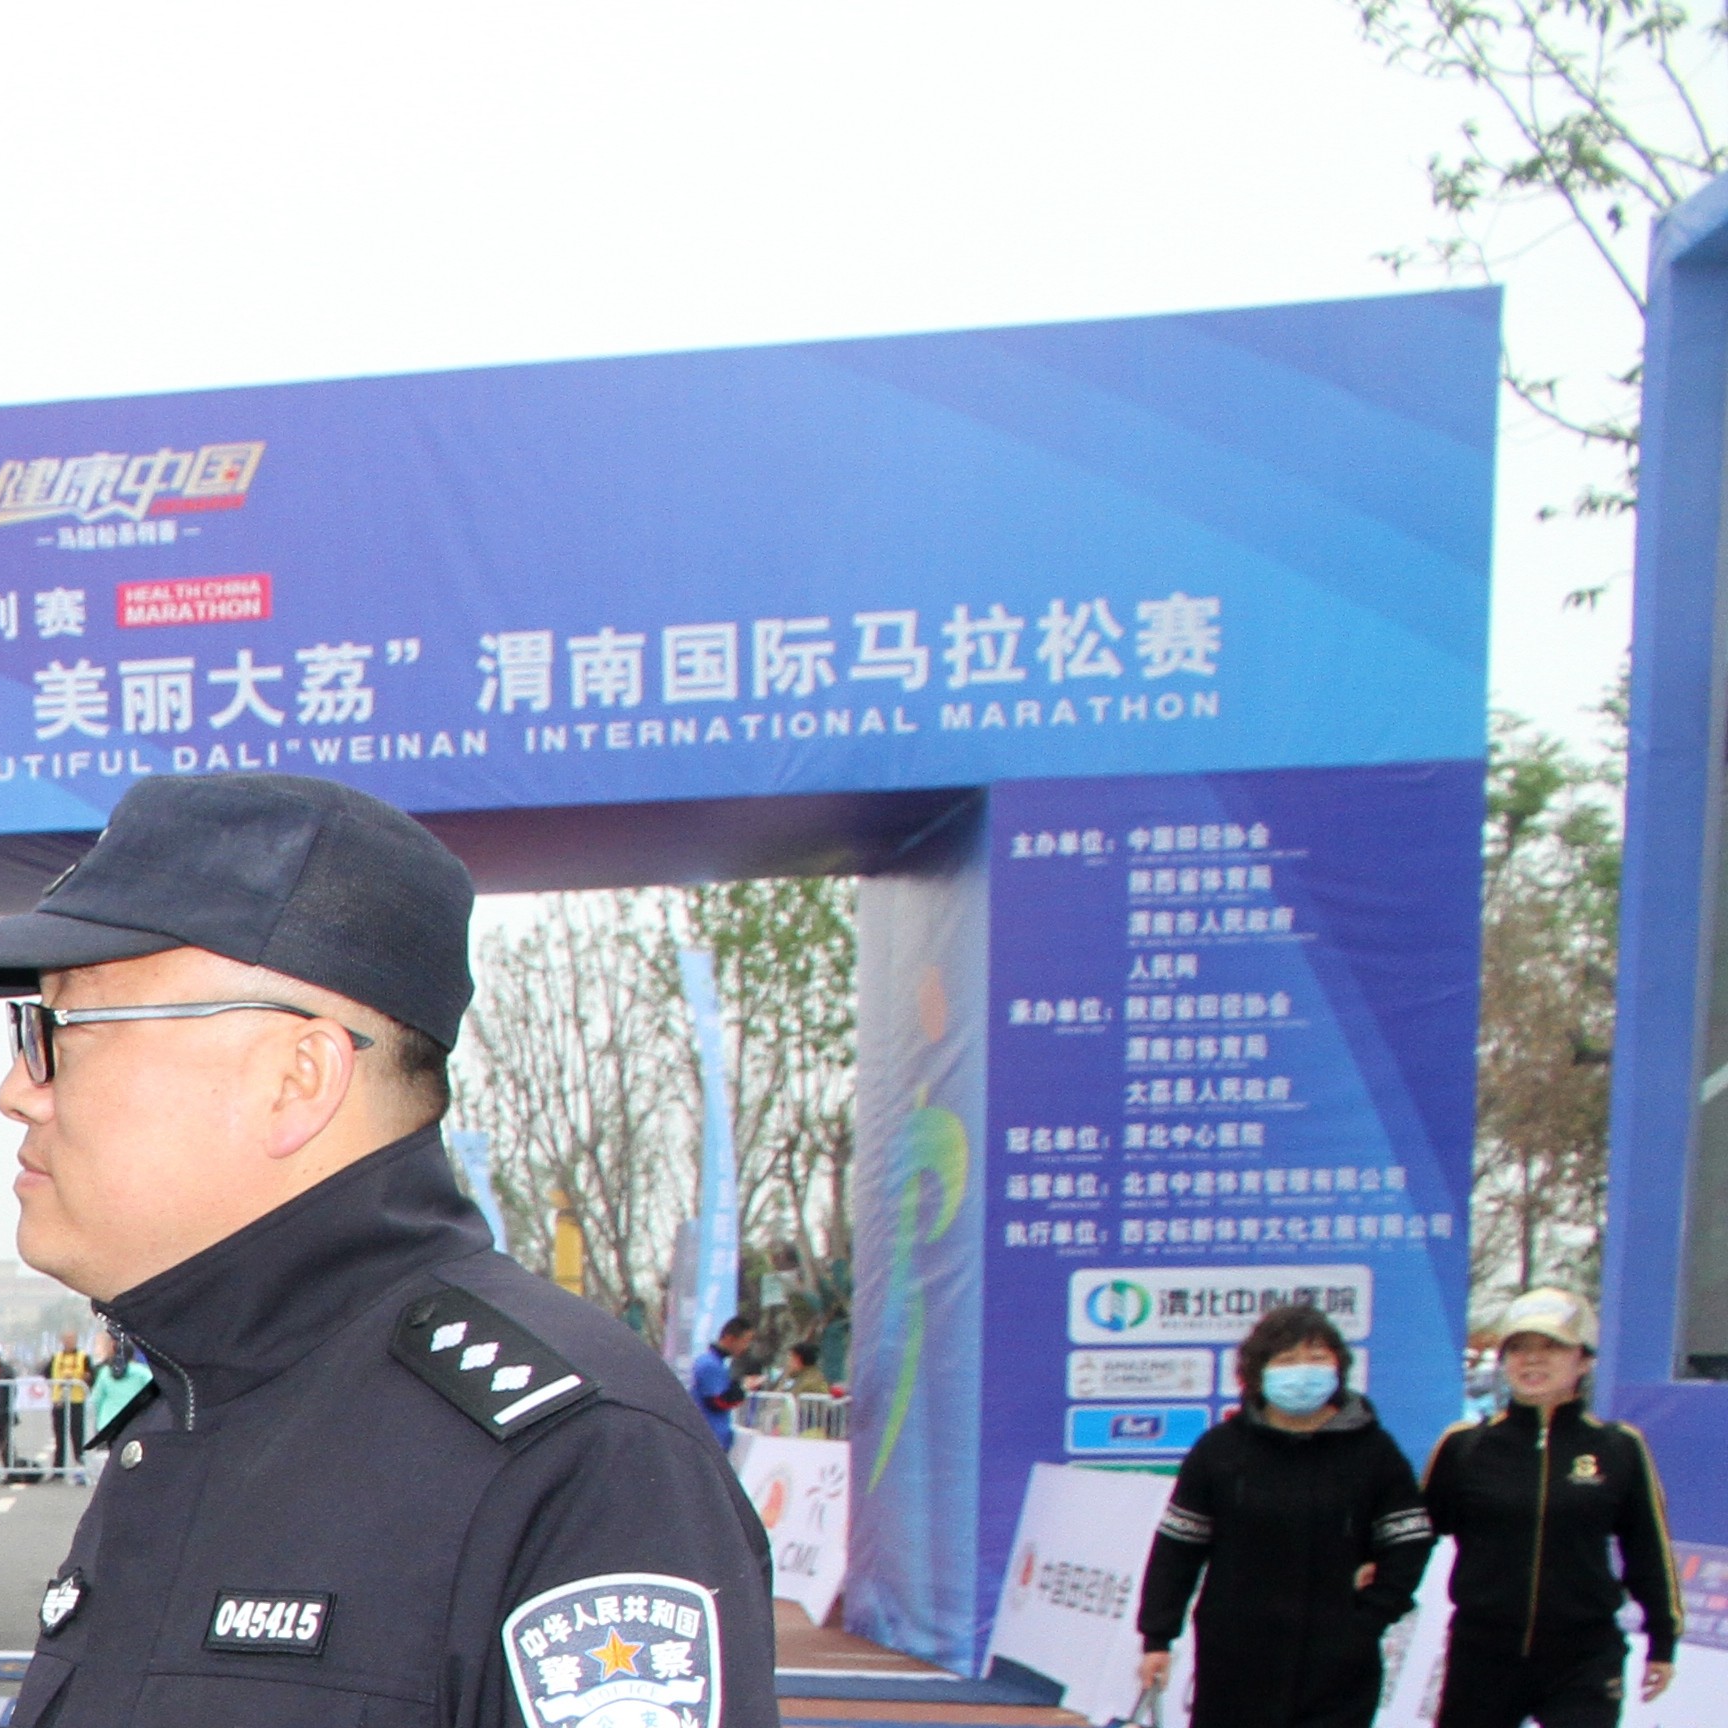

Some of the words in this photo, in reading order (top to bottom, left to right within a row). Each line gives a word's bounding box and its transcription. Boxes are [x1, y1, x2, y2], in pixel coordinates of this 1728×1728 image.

[124, 598, 262, 625] MARATHON
[125, 583, 201, 602] HEALTH
[203, 579, 262, 597] CHINA
[475, 592, 1223, 715] 渭南国际马拉松赛
[524, 705, 920, 755] INTERNATIONAL
[940, 690, 1222, 731] MARATHON
[215, 1600, 322, 1641] 045415
[519, 1595, 701, 1659] 中华人民共和国
